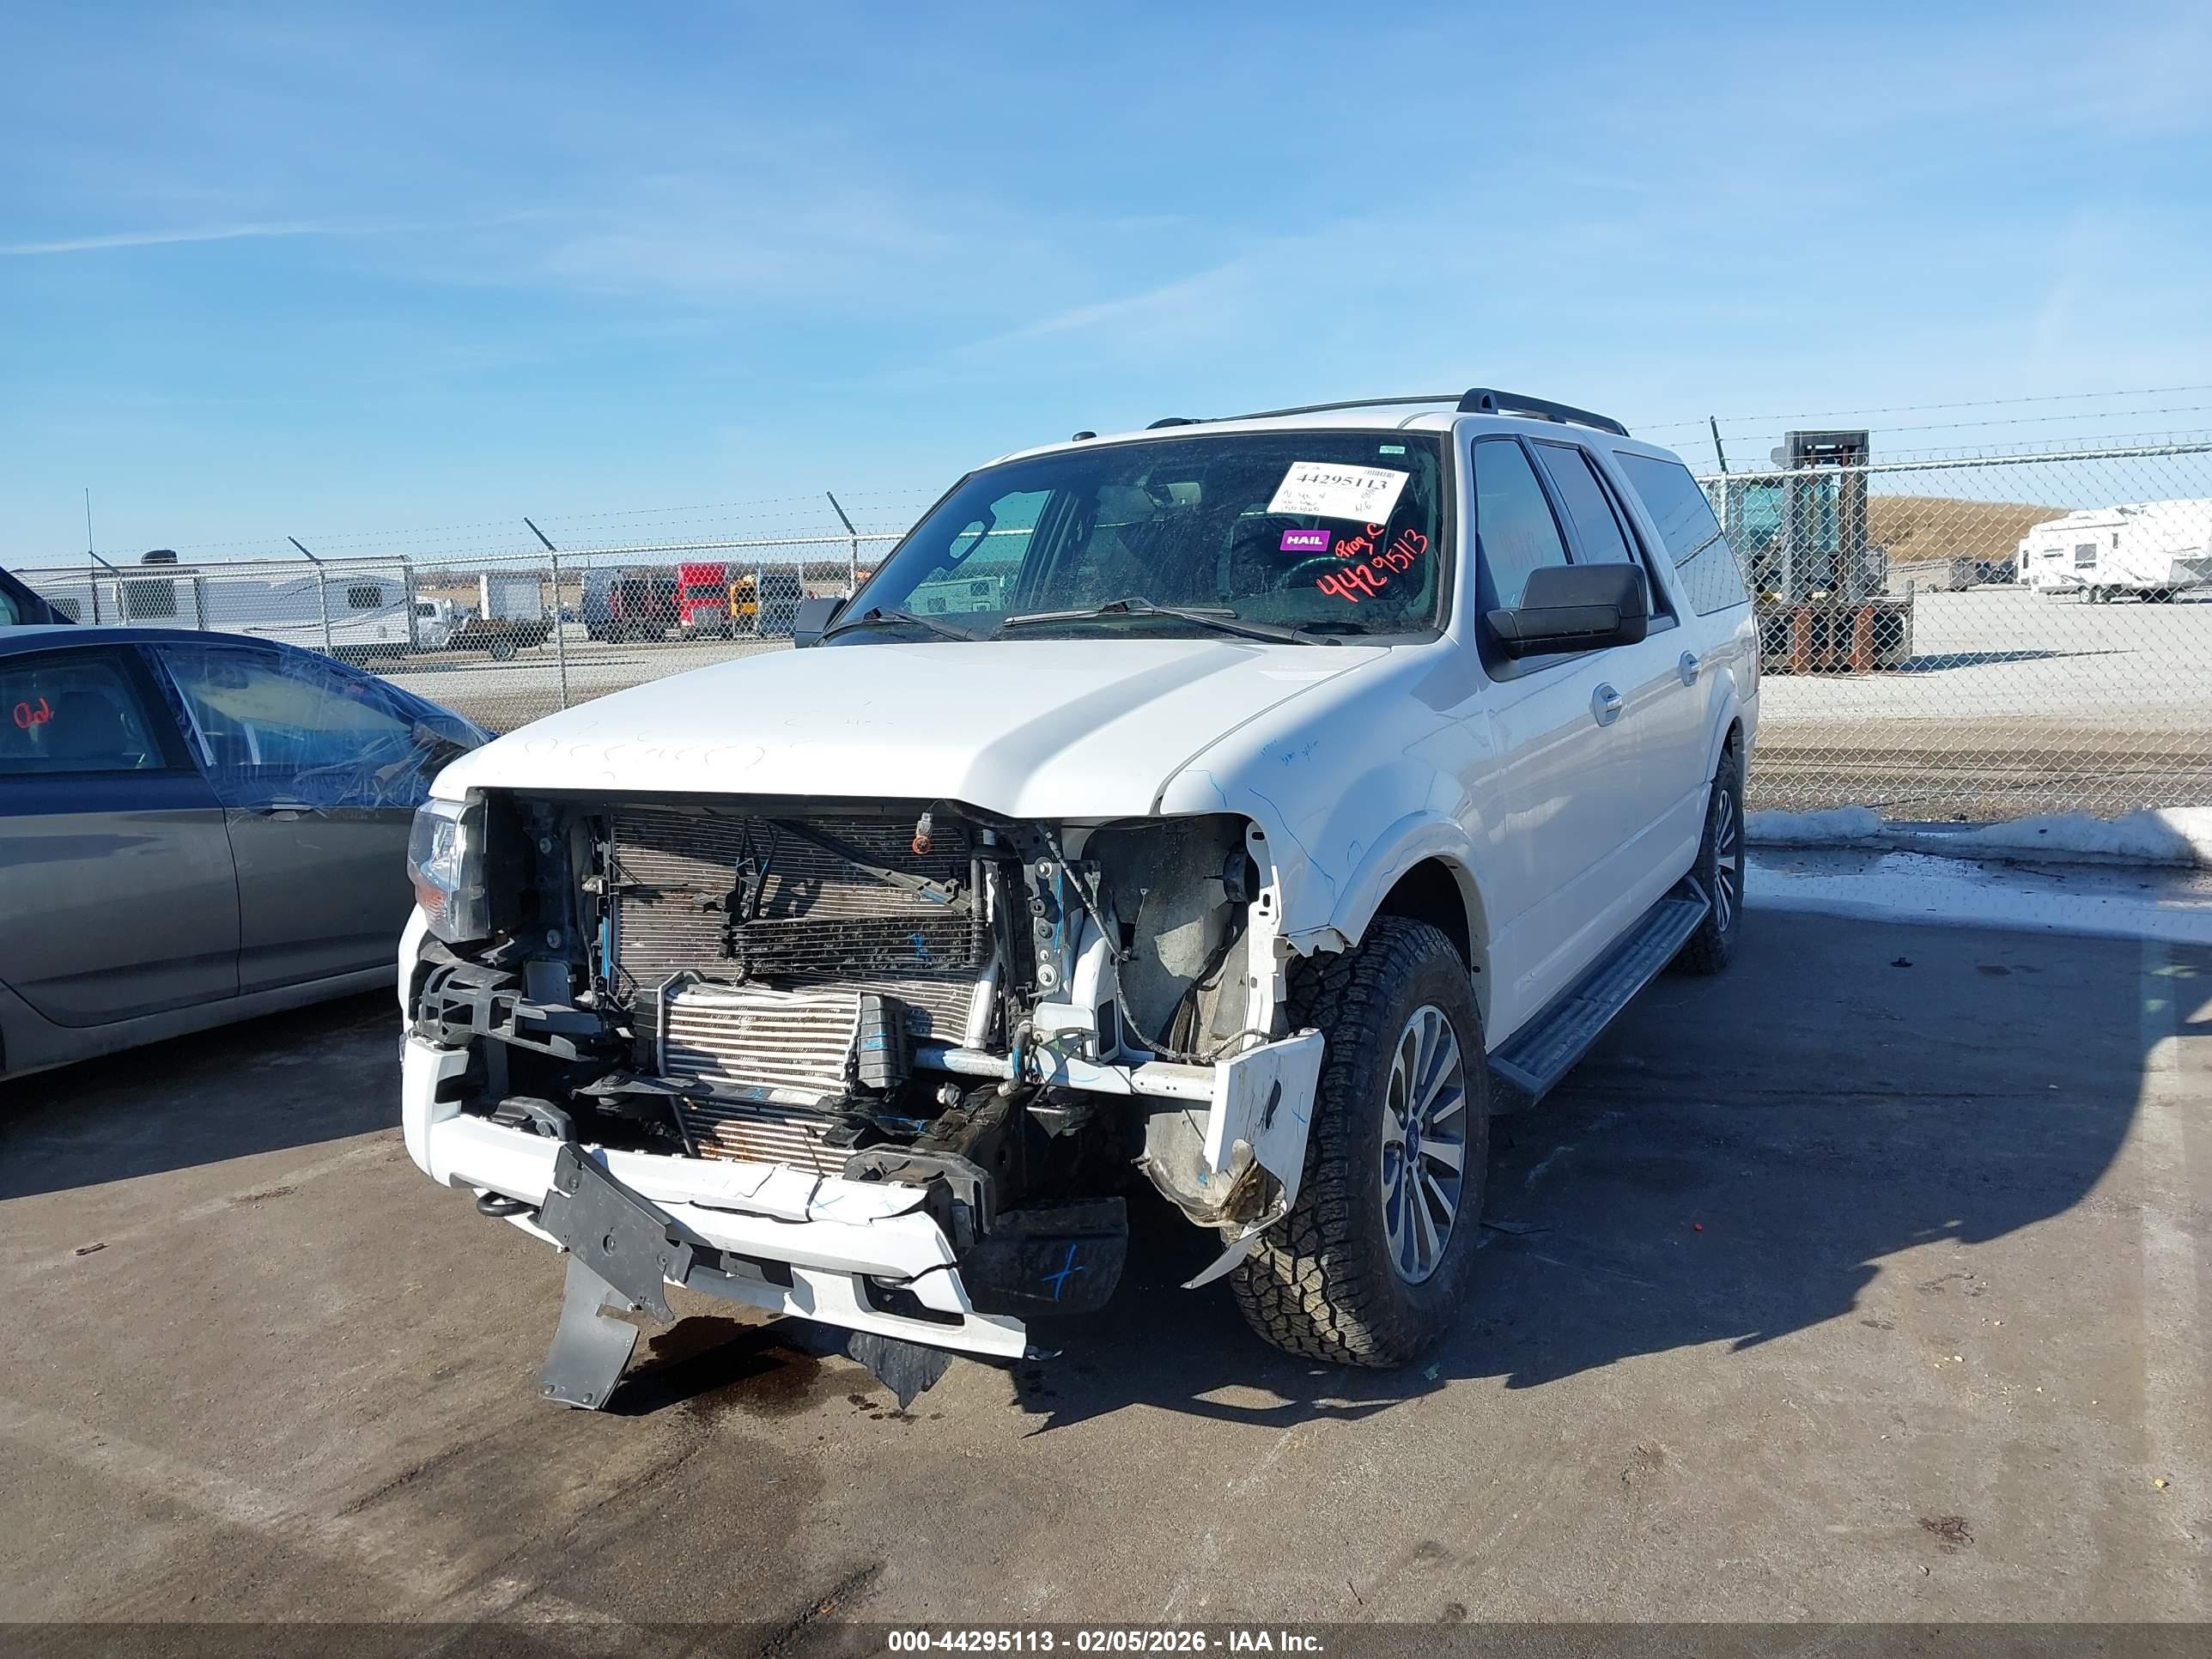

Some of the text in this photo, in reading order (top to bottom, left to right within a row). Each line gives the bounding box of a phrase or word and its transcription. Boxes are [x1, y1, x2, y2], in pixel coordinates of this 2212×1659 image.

[1296, 473, 1389, 490] 44295113
[1286, 536, 1323, 545] HAIL
[1316, 529, 1428, 603] 44295113
